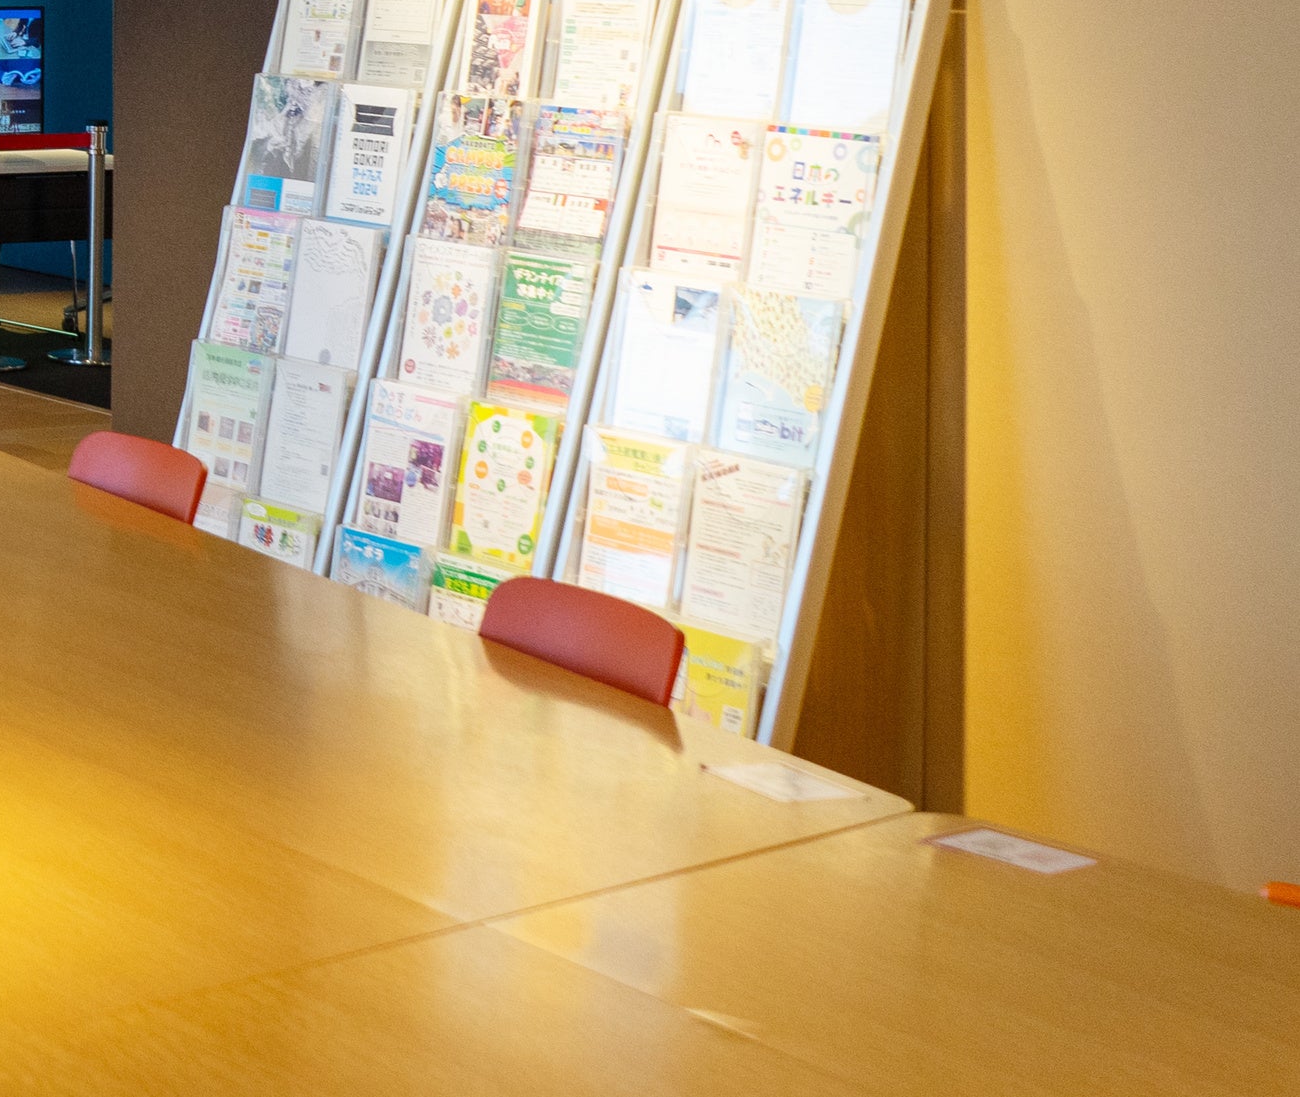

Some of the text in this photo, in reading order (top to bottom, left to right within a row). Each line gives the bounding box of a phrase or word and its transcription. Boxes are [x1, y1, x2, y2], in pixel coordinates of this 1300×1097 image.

[792, 161, 840, 183] 日本の
[772, 185, 853, 208] エネルギー
